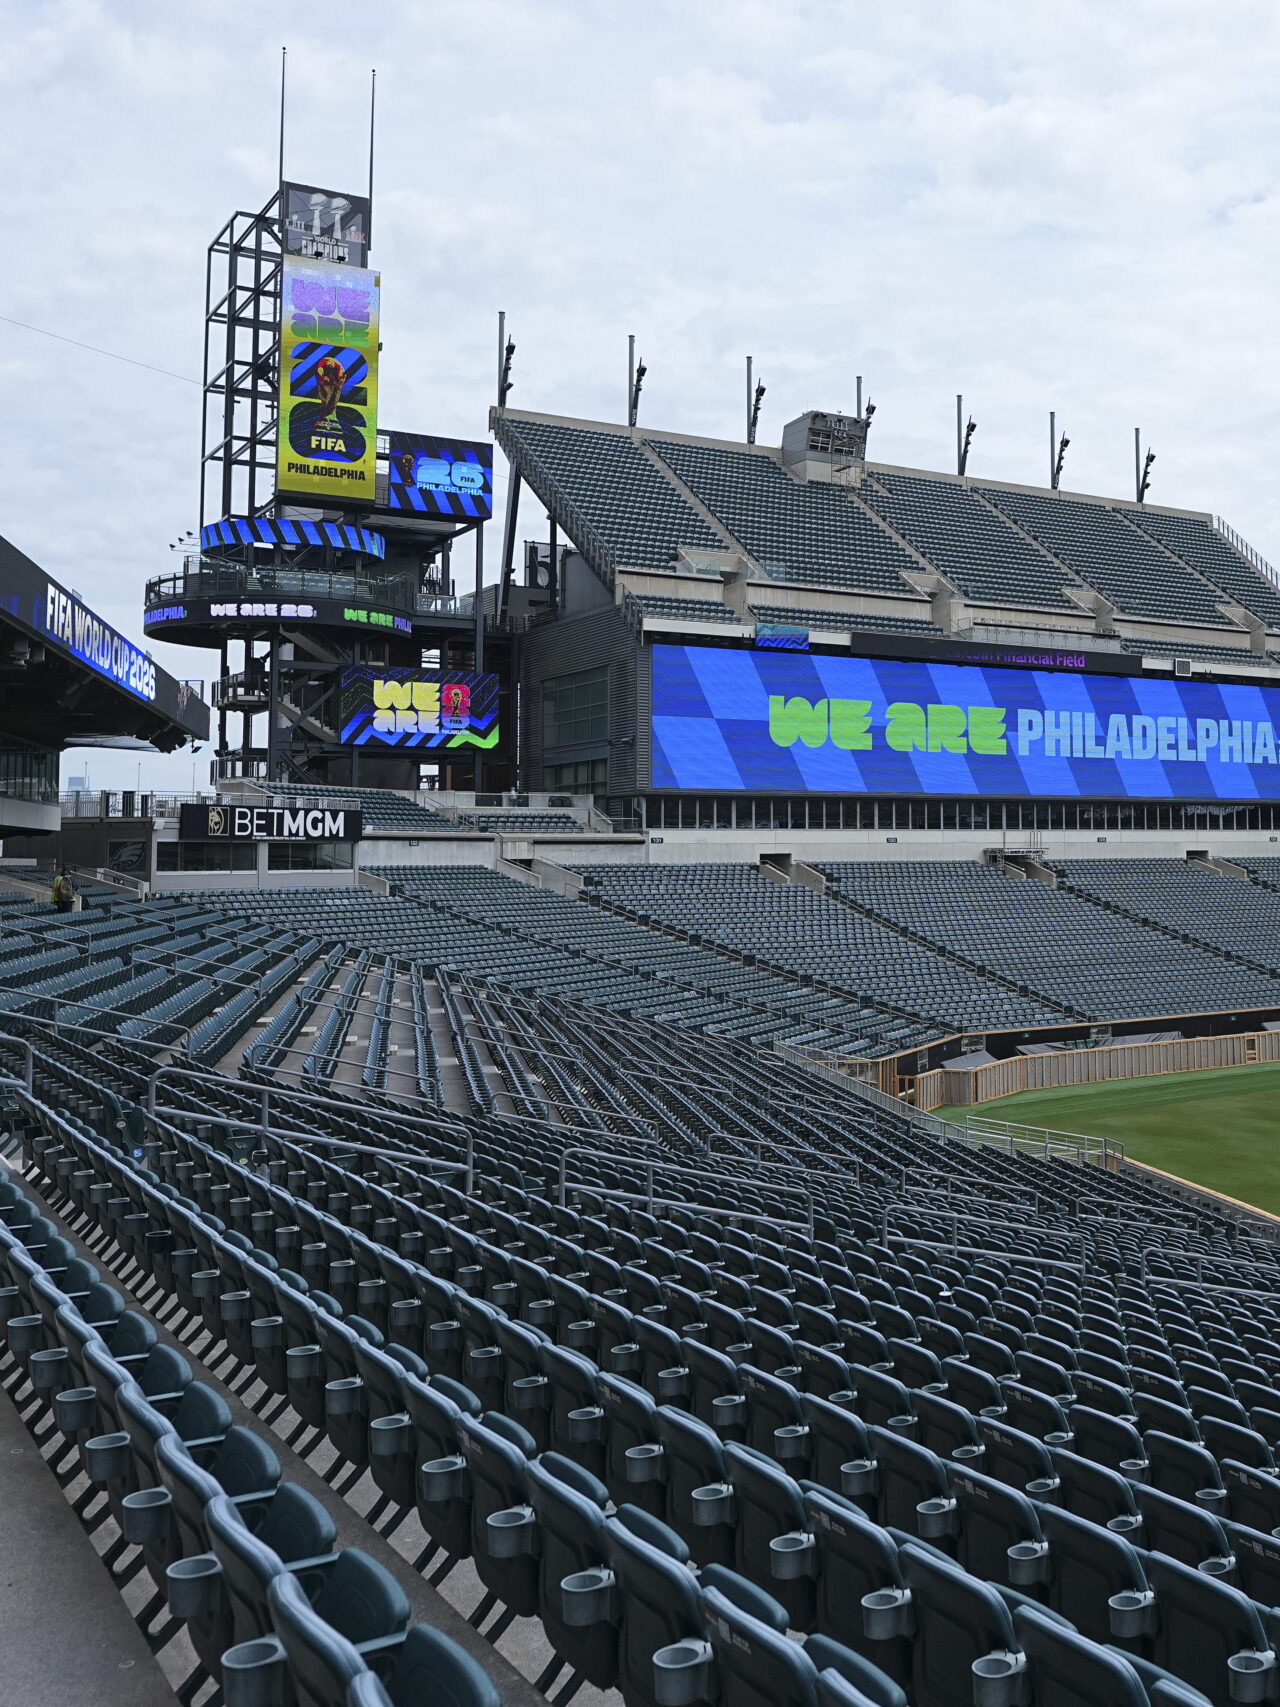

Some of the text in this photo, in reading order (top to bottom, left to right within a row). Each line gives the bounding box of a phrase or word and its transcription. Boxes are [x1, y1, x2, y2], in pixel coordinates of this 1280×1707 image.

[302, 240, 348, 261] CHAMPIONS
[314, 235, 336, 245] WORLD
[292, 279, 370, 322] WE
[291, 312, 370, 348] ARE
[311, 436, 346, 452] FIFA
[288, 462, 366, 480] PHILADELPHIA
[417, 456, 484, 488] 26
[417, 482, 483, 496] PHILADELPHIA
[210, 604, 238, 616] WE
[240, 604, 278, 616] ARE
[344, 608, 367, 623] WE
[370, 612, 393, 628] ARE
[46, 582, 156, 700] FIFA WORLD CUP 2026
[1056, 652, 1085, 668] Field
[373, 680, 440, 711] WE
[373, 709, 440, 734] ARE
[769, 695, 872, 750] WE
[885, 703, 1006, 755] ARE
[1018, 708, 1278, 764] PHILADELPHIA
[235, 808, 344, 837] BETMGM
